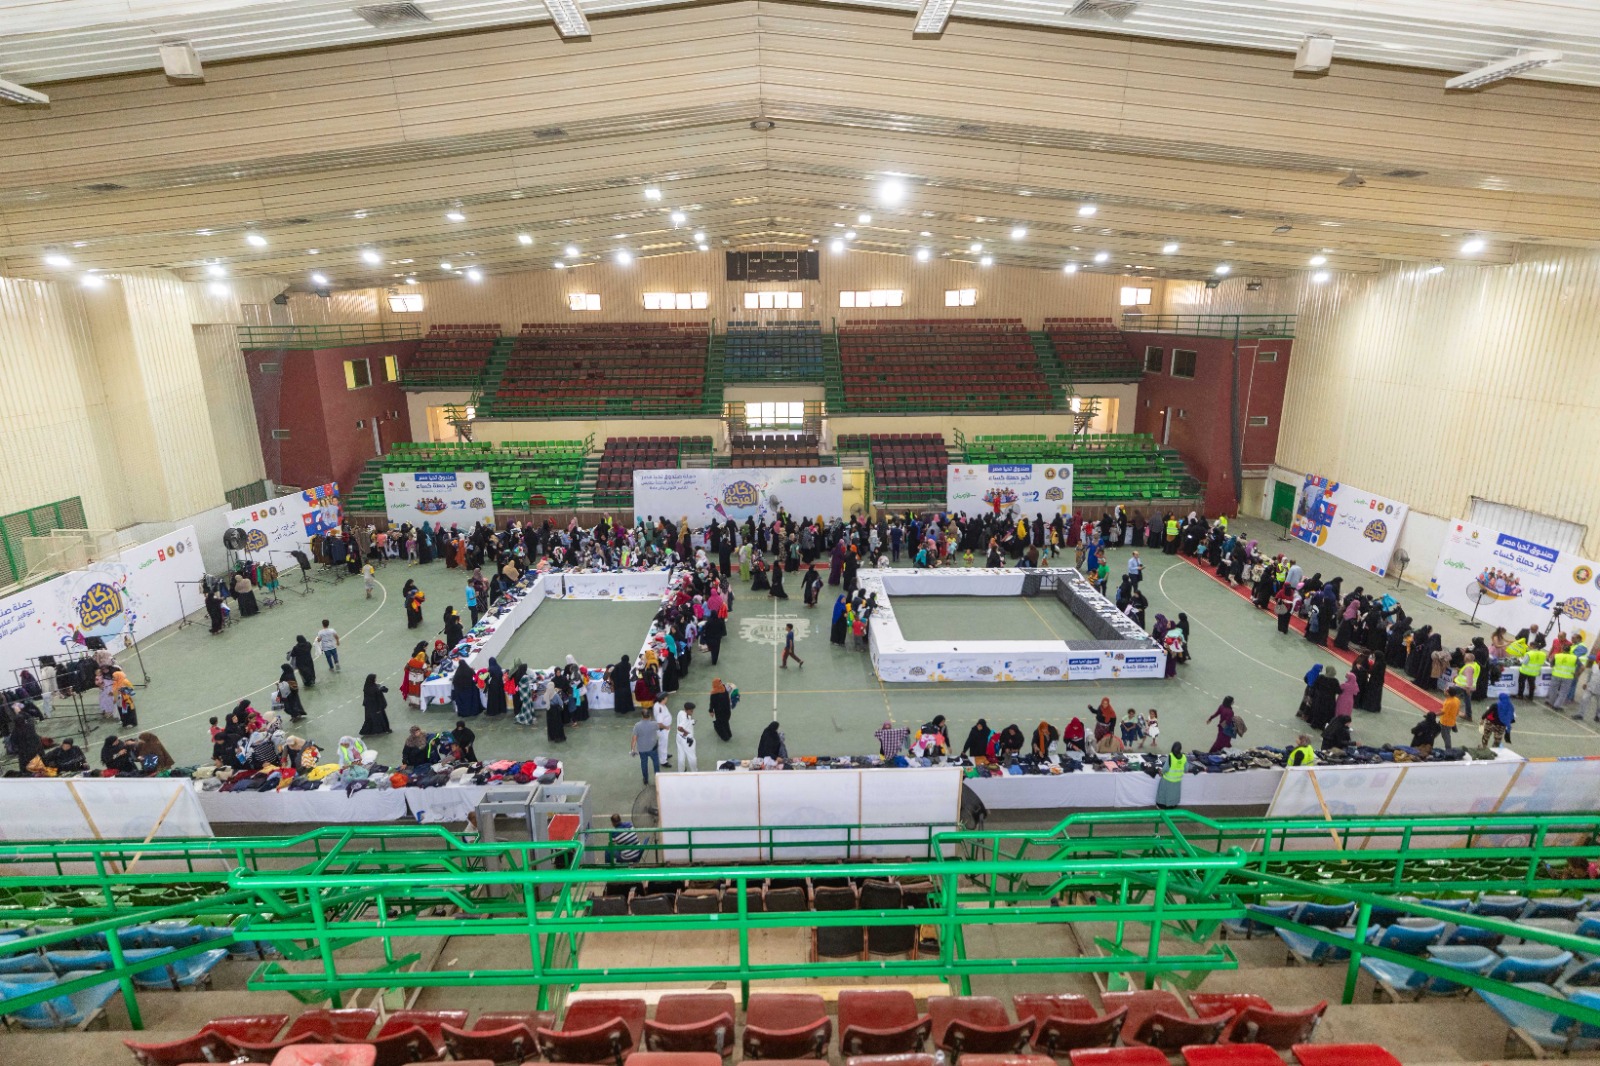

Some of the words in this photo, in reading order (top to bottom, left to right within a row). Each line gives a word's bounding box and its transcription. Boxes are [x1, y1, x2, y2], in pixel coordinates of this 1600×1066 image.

[727, 482, 754, 496] دكان
[725, 491, 757, 507] الفرحة
[1033, 490, 1040, 502] 2
[460, 499, 467, 510] 2
[1502, 538, 1516, 547] مصر
[1517, 541, 1530, 551] تحيا
[1493, 549, 1515, 561] كساء
[1516, 554, 1535, 568] حملة
[1535, 562, 1554, 574] أكبر
[81, 583, 114, 611] دكان
[1541, 593, 1555, 610] 2
[12, 599, 33, 611] حملة
[82, 596, 121, 627] الفرحة
